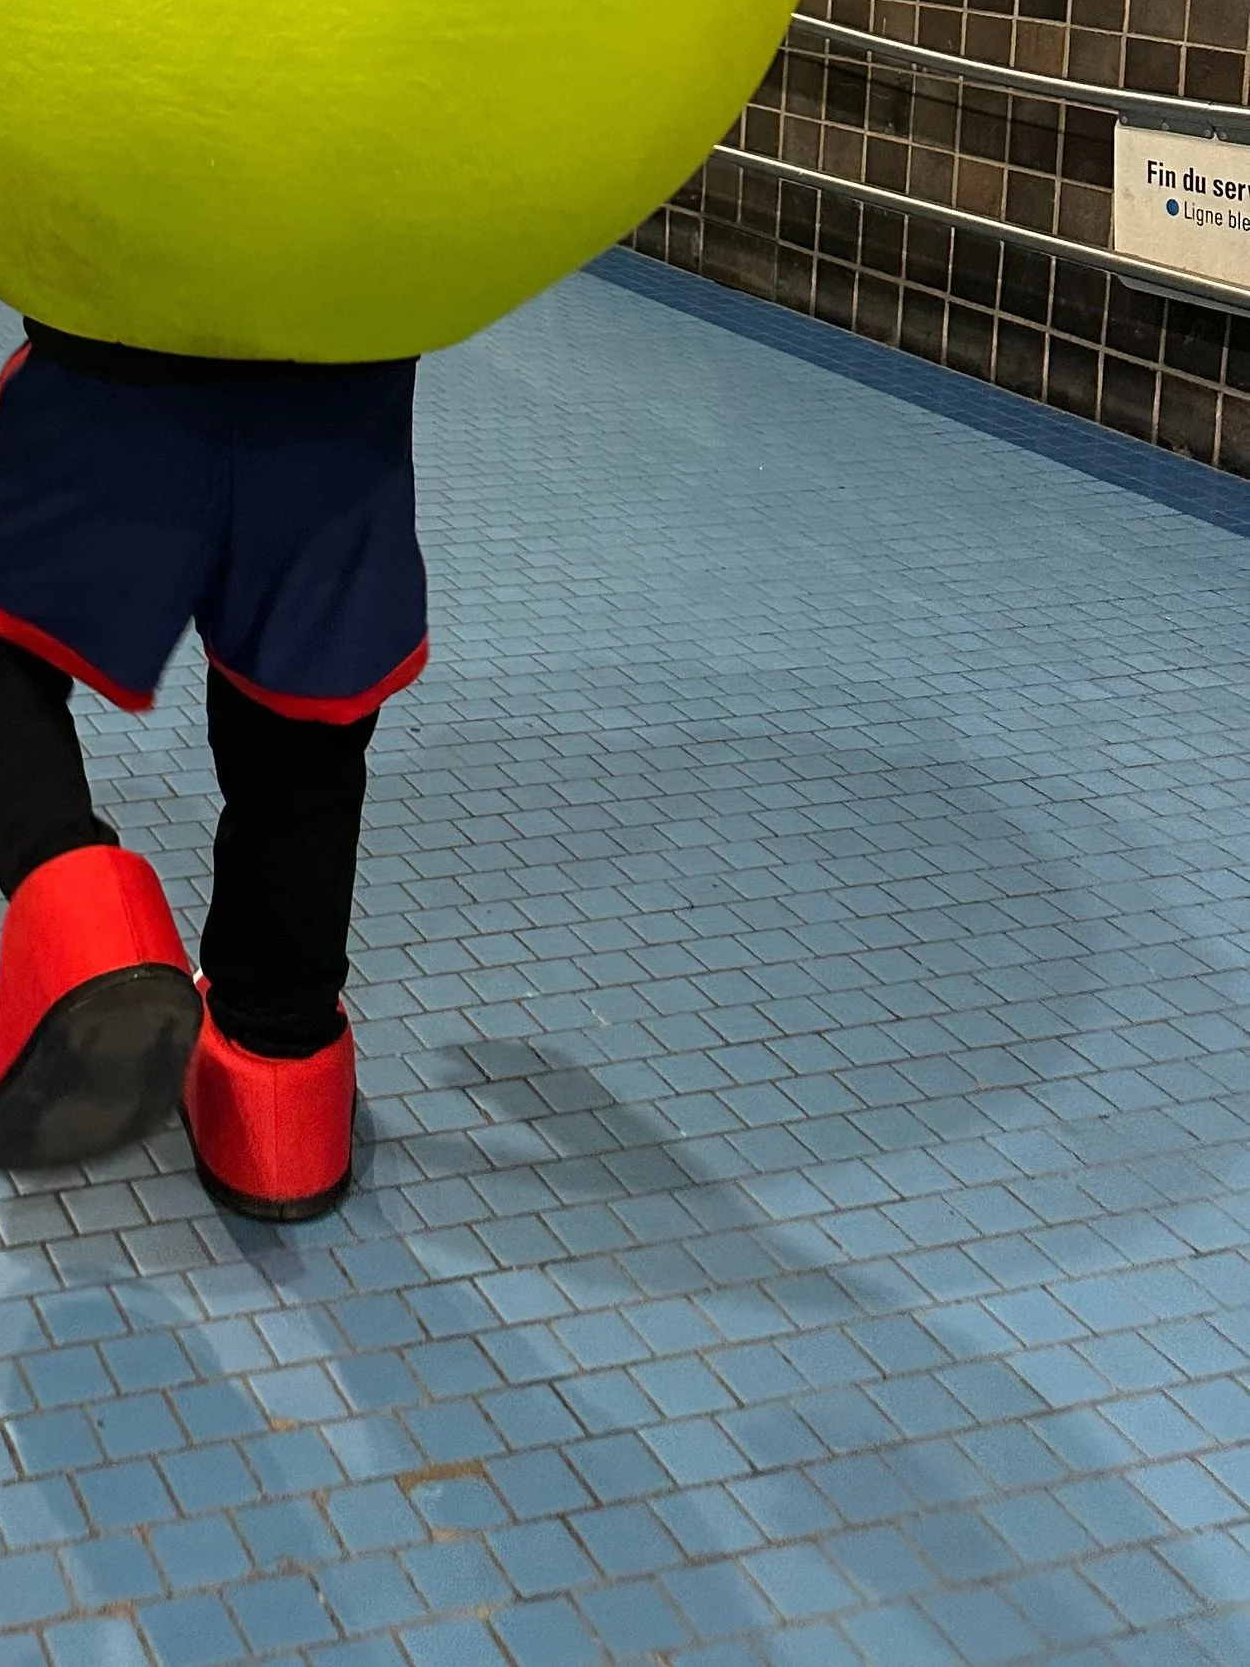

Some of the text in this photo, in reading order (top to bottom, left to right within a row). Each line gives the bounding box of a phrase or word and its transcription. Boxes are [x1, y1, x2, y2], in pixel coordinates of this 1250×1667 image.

[1147, 160, 1250, 201] Fin du ser
[1184, 200, 1223, 226] Ligne
